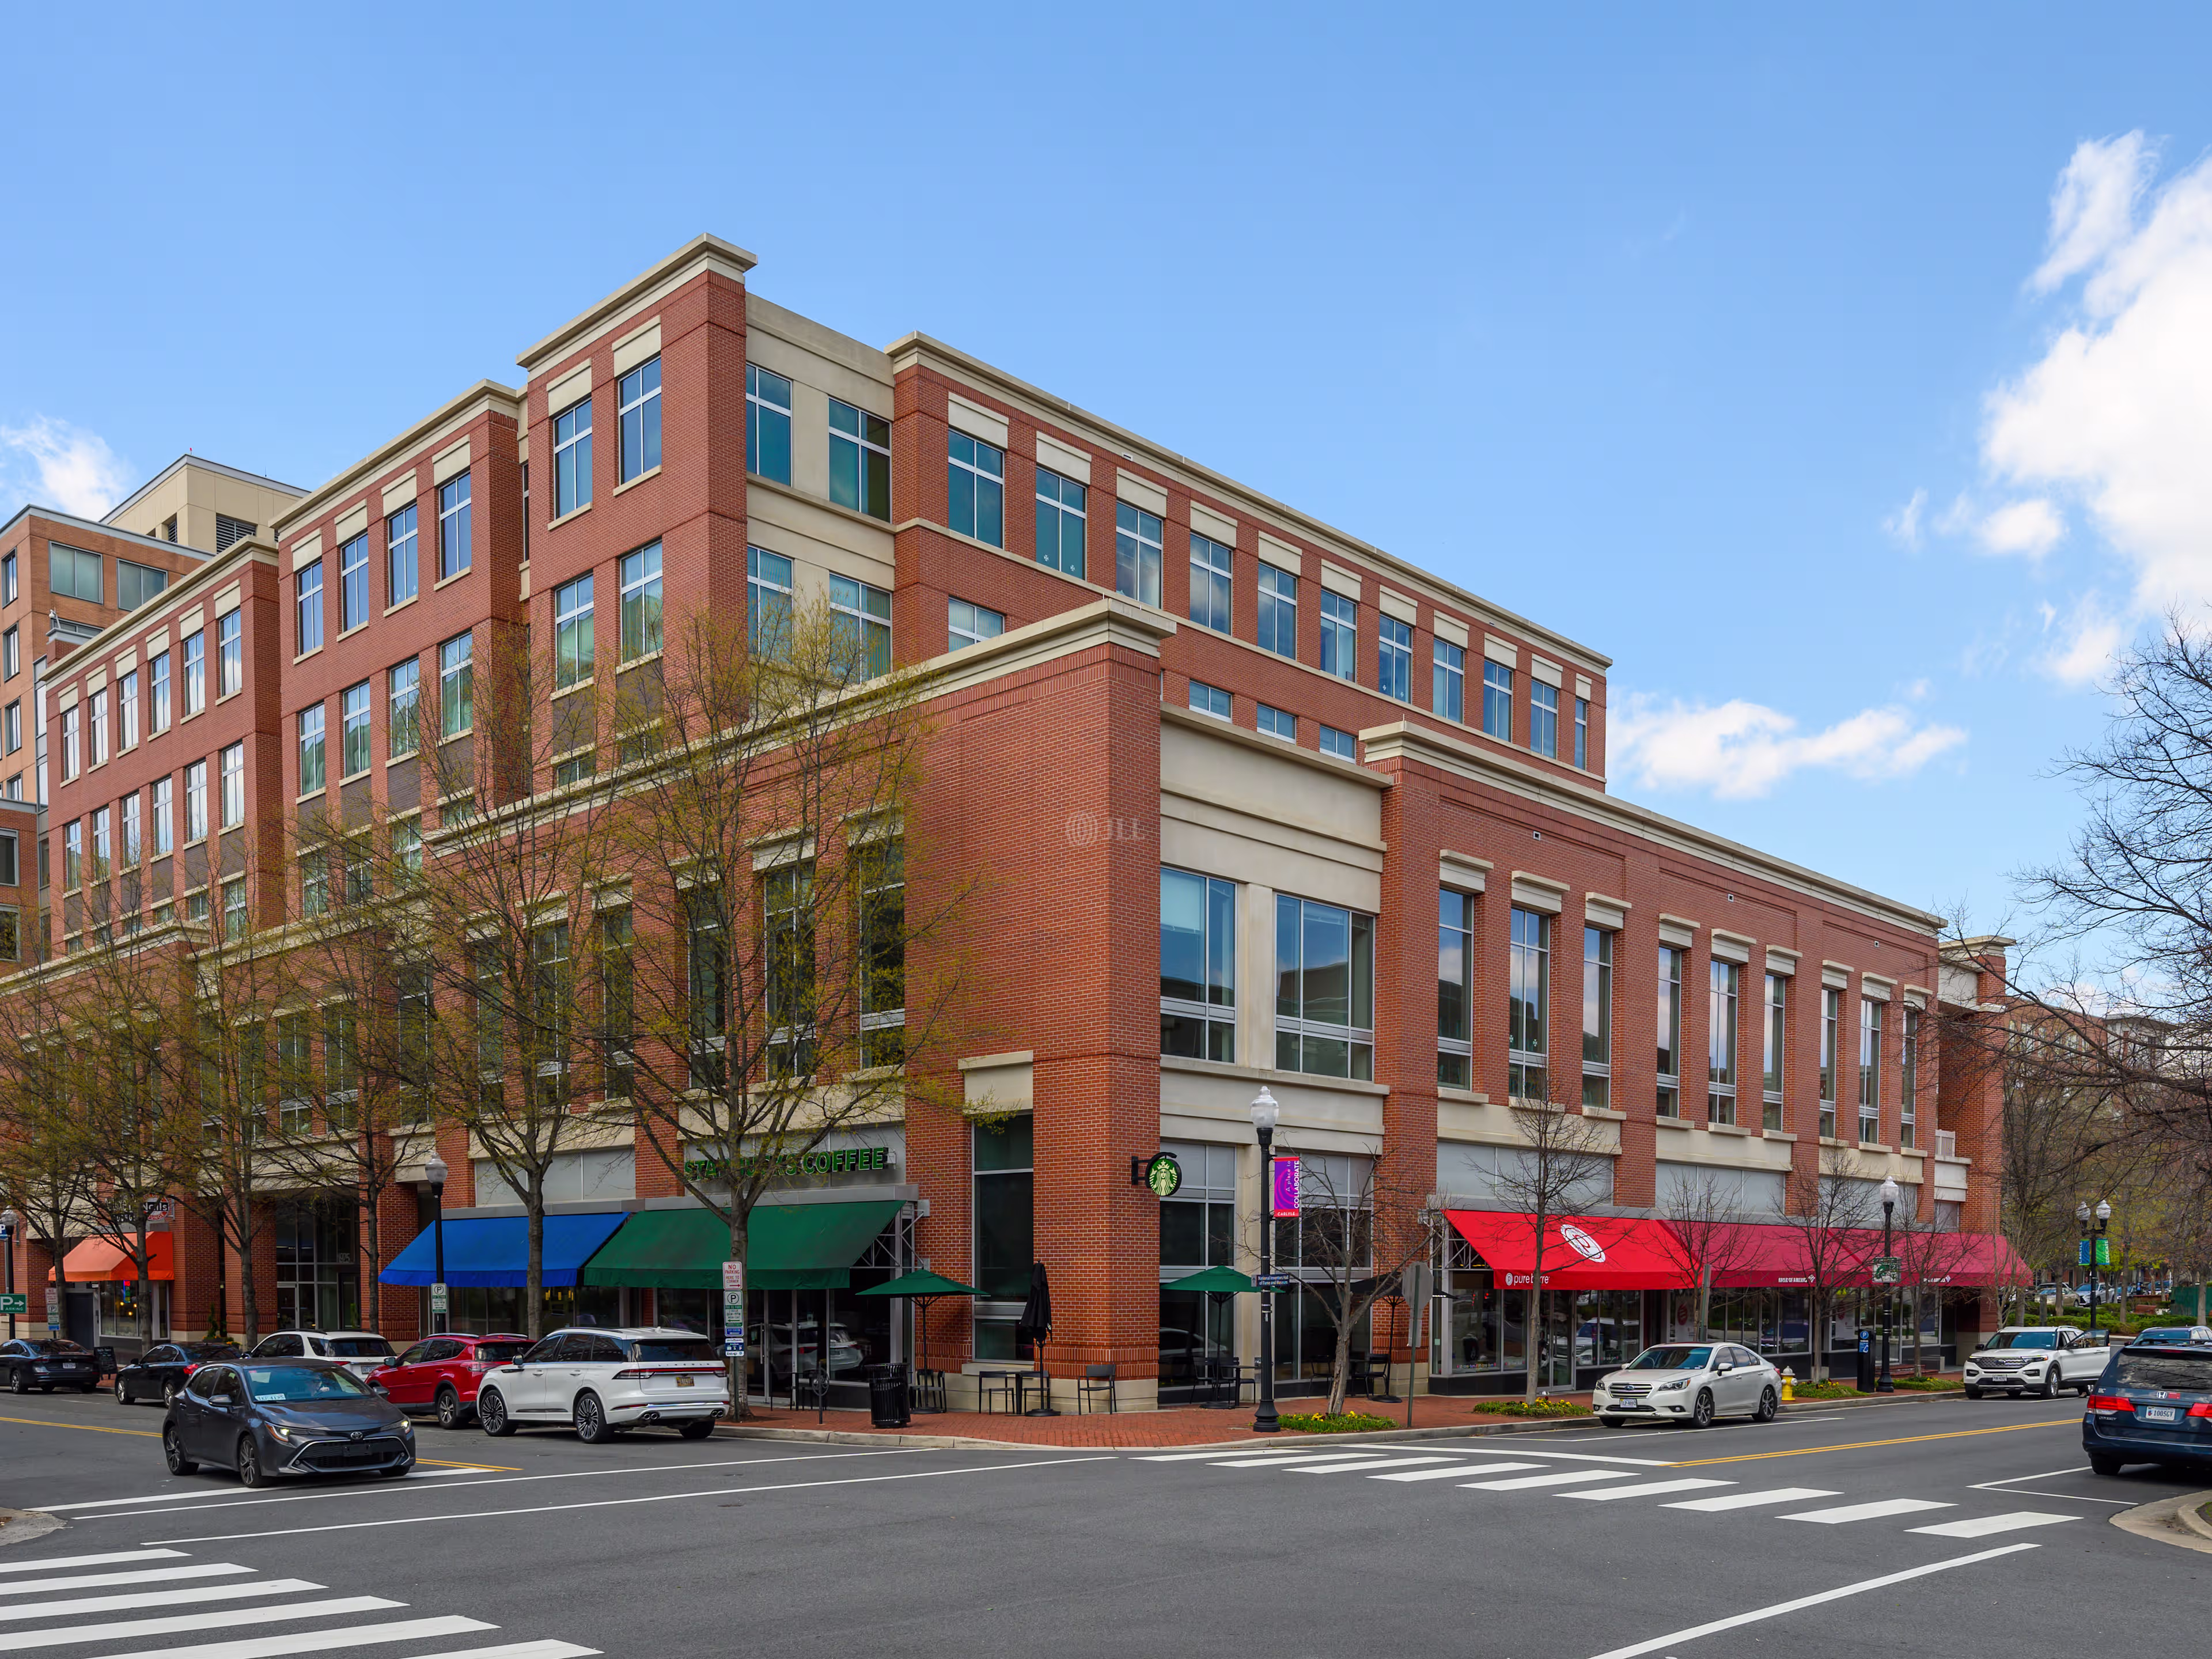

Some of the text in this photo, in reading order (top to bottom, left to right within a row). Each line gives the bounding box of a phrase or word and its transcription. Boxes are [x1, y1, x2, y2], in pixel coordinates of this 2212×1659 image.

[803, 1147, 885, 1175] COFFEE
[1513, 1275, 1531, 1286] pure
[1531, 1273, 1549, 1284] brre
[731, 1295, 736, 1303] P
